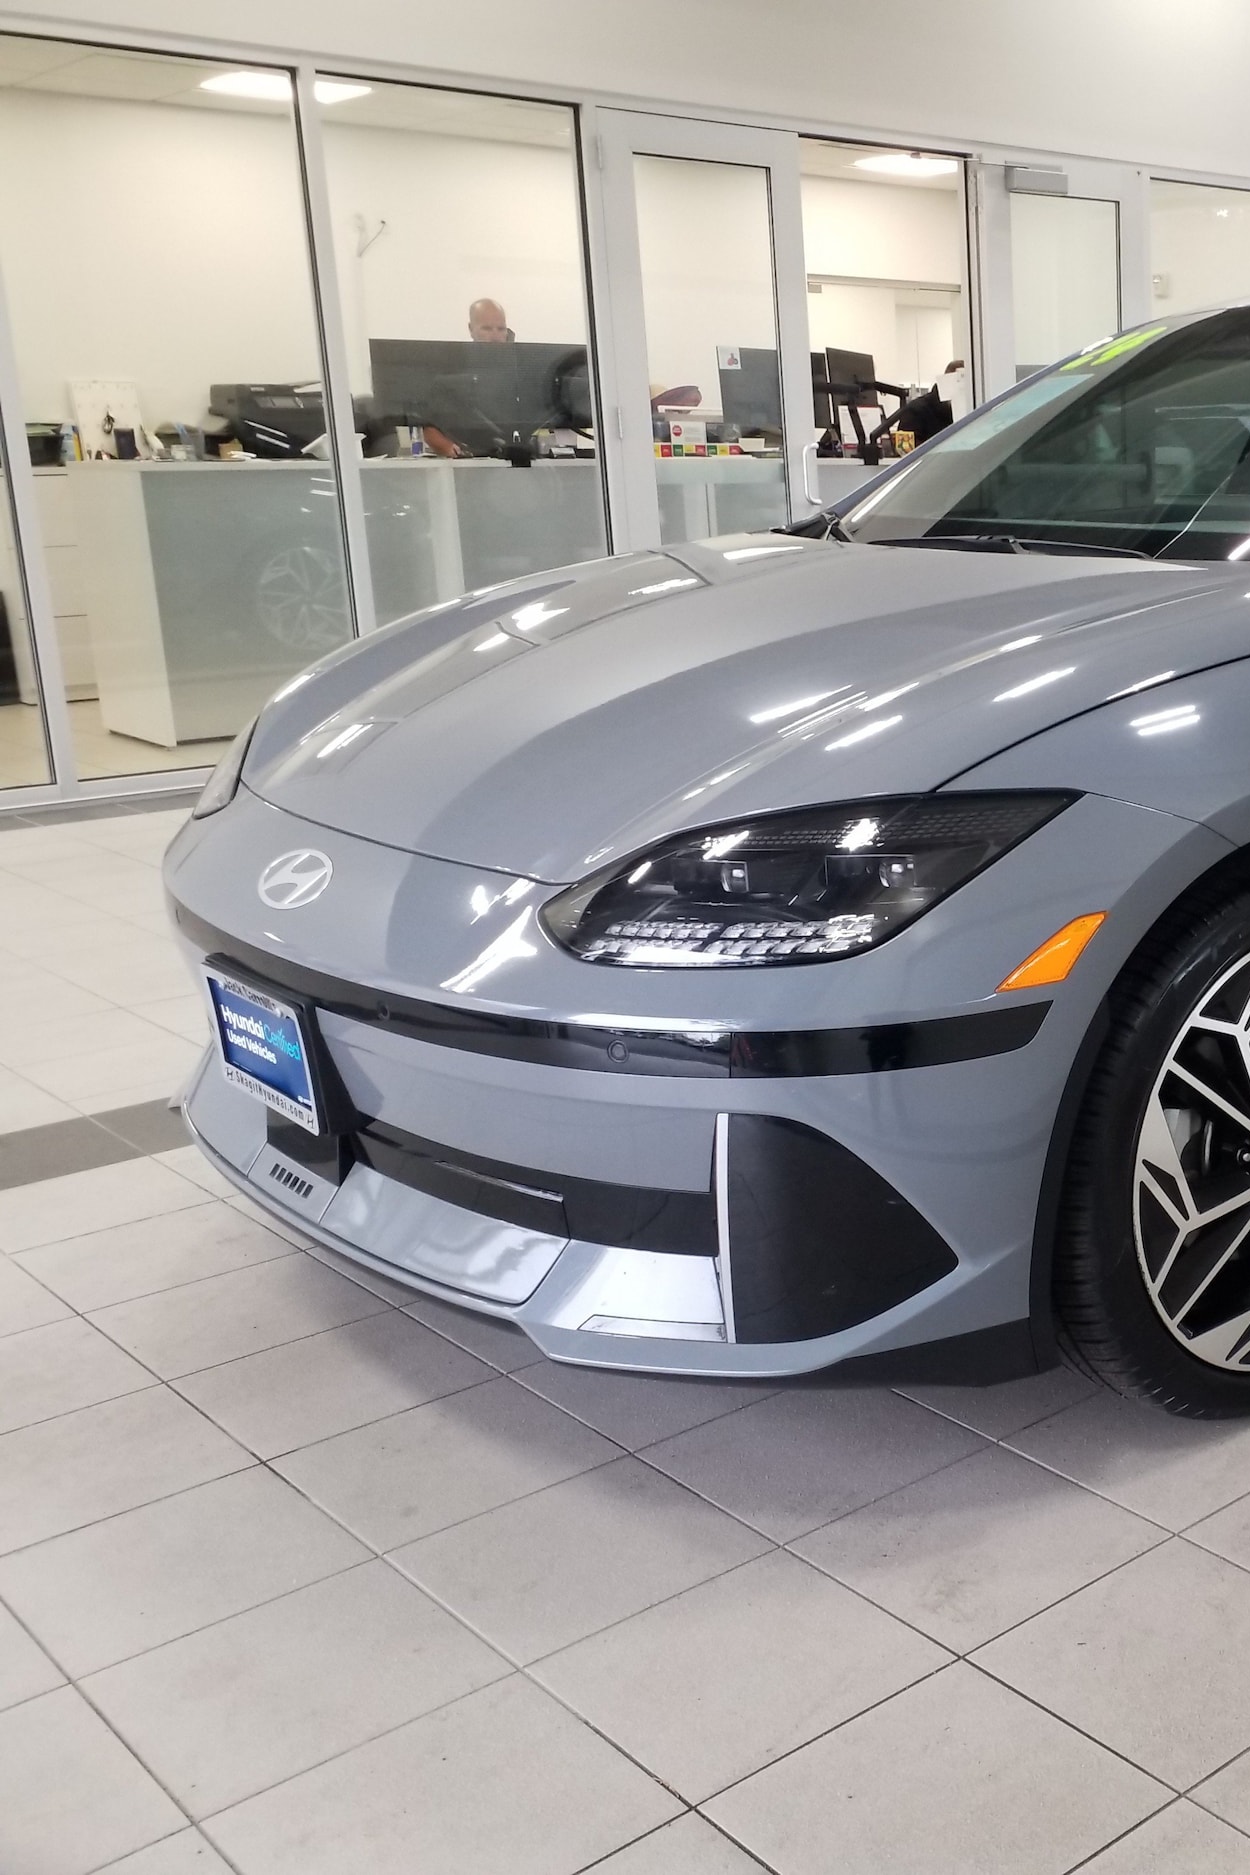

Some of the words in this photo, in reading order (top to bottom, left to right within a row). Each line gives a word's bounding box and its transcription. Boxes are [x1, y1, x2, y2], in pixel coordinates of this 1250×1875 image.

[220, 1004, 265, 1040] Hyundai
[226, 1030, 247, 1050] Used
[246, 1036, 277, 1064] Vehicles
[235, 1070, 304, 1121] SkagitHyundai.com
